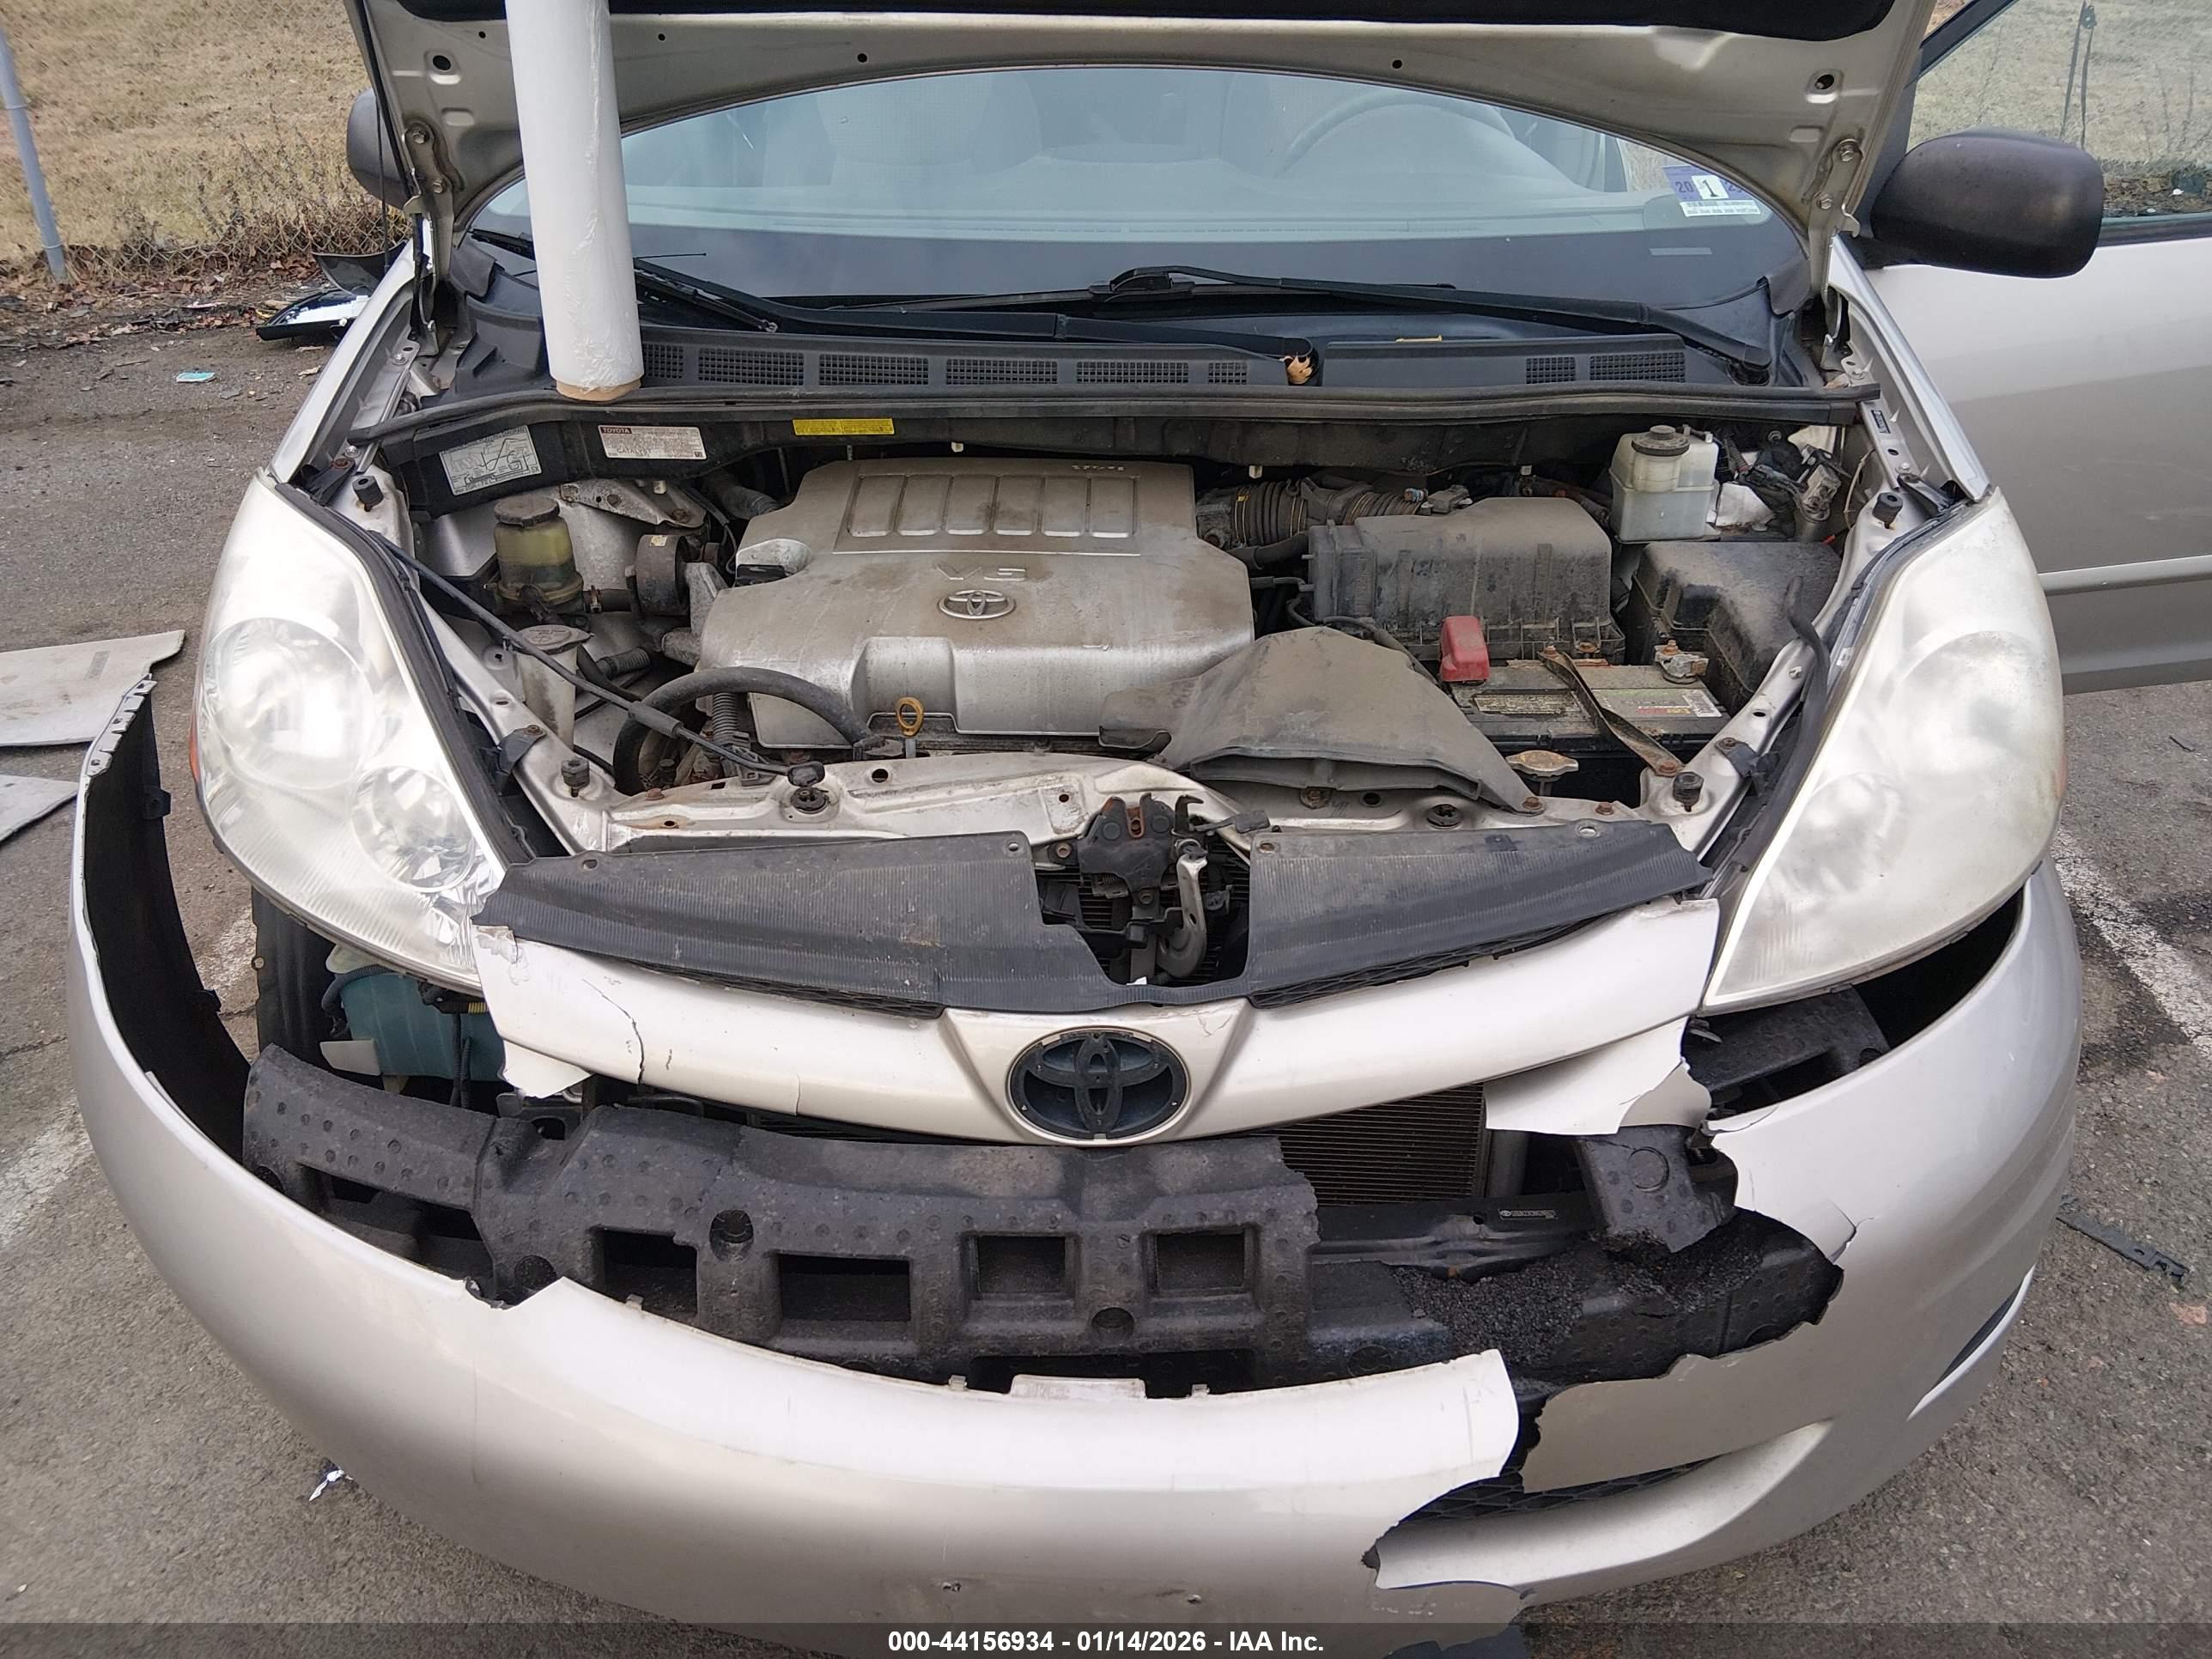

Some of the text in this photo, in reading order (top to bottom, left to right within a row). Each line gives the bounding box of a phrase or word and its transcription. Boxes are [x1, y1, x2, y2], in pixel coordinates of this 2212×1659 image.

[1675, 181, 1694, 193] 20
[1702, 179, 1718, 198] 1
[934, 564, 1028, 581] V6
